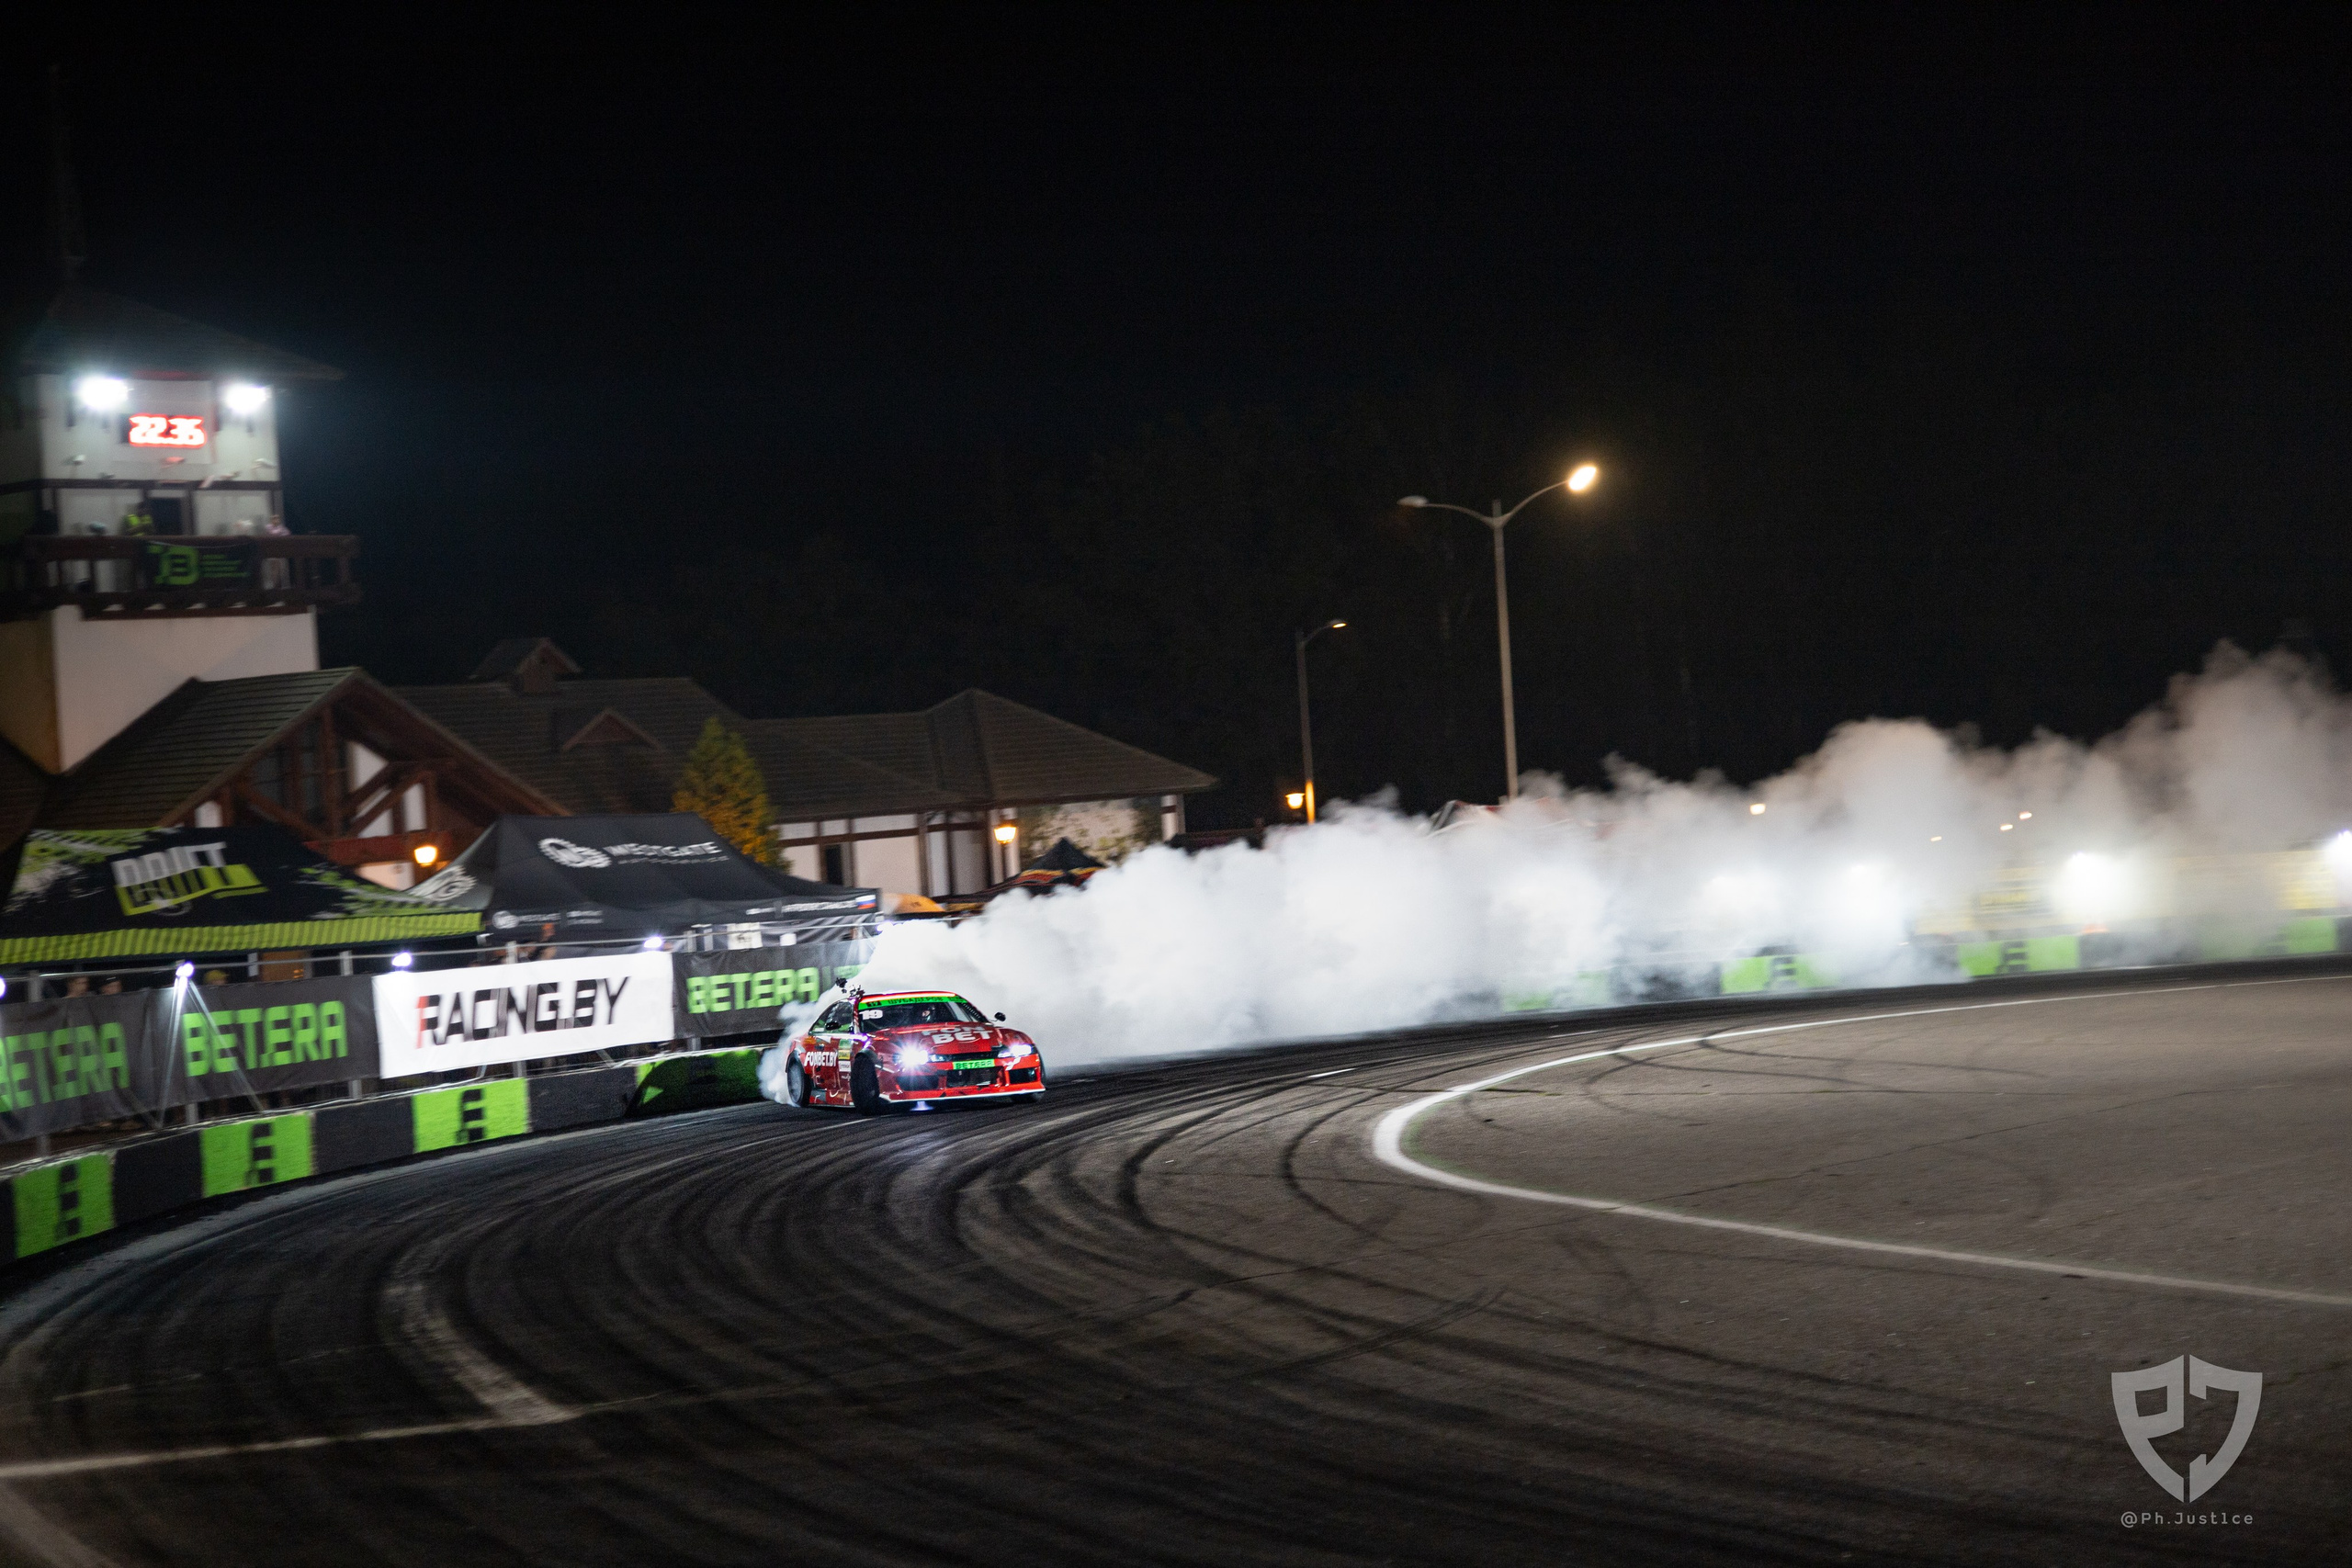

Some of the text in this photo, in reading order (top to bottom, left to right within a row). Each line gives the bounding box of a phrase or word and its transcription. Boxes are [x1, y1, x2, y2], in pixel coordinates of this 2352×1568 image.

[687, 967, 820, 1013] BETERA
[859, 1010, 883, 1020] 19
[183, 1000, 348, 1077] BETERA
[932, 1030, 993, 1044] BET
